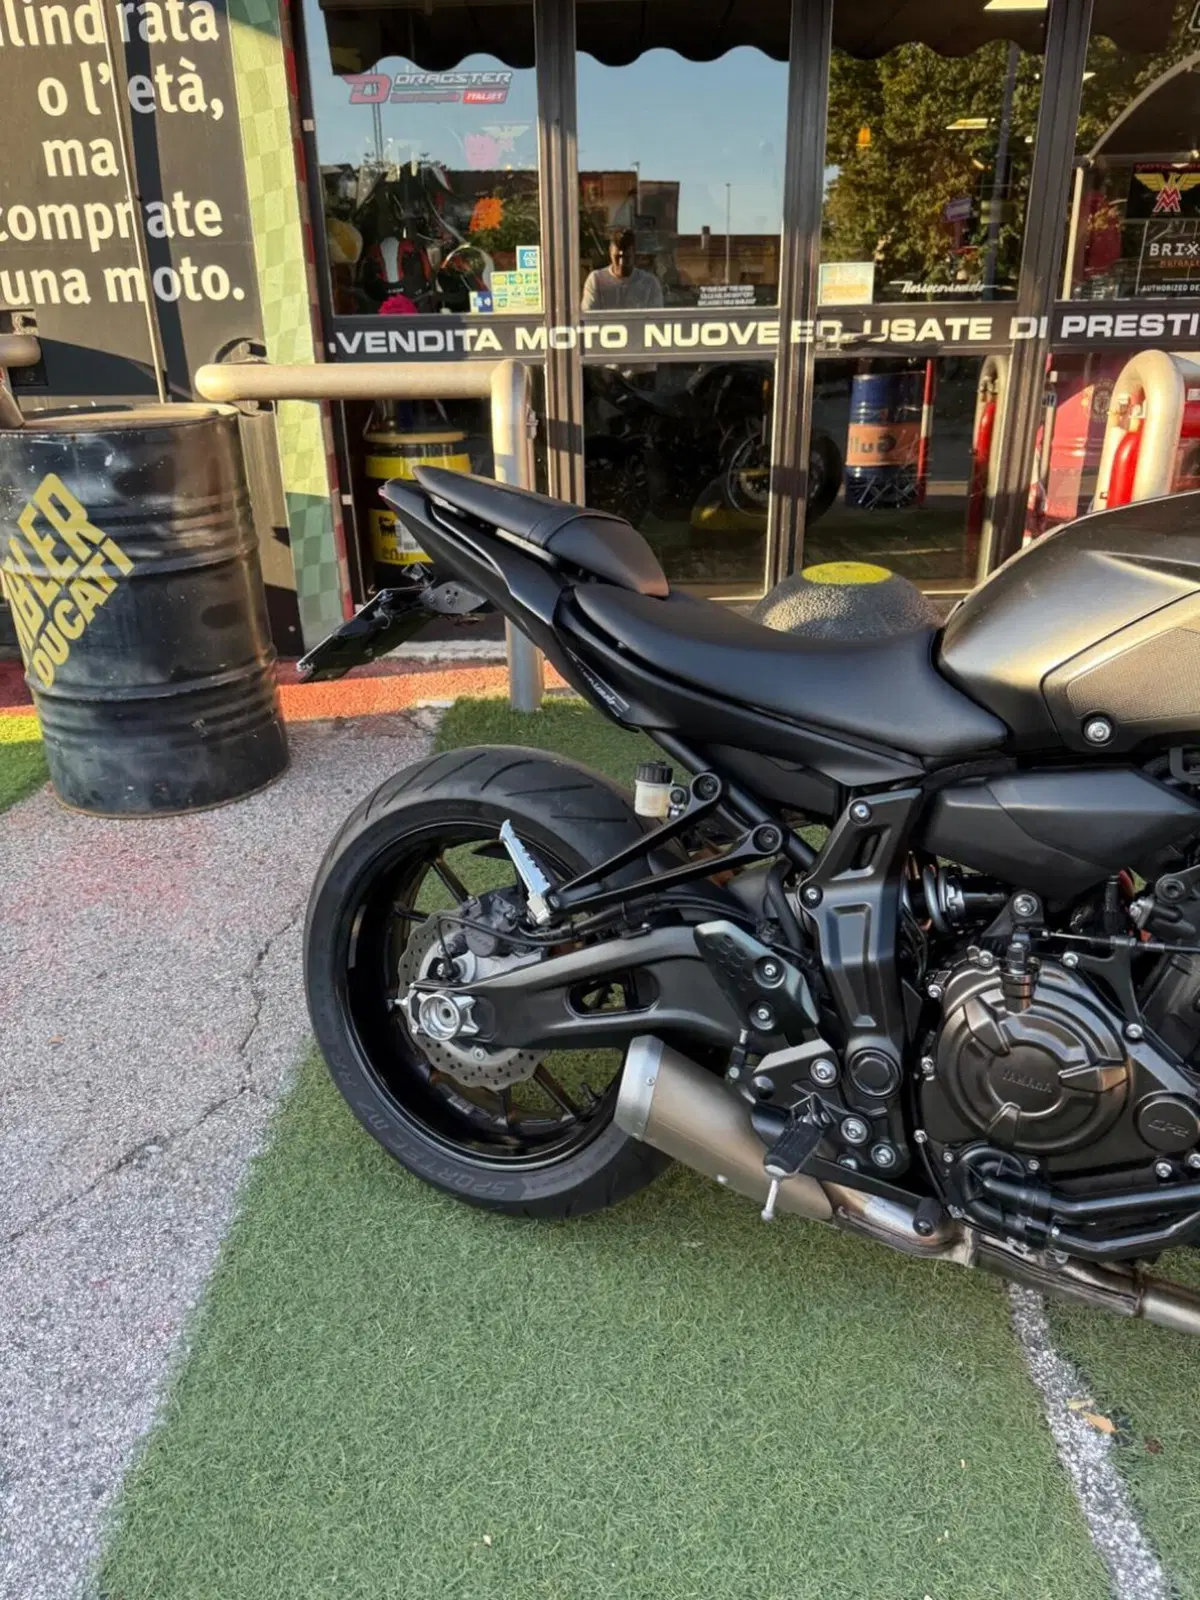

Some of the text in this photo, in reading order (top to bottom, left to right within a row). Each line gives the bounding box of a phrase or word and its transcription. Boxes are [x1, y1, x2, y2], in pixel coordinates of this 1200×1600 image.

[0, 0, 220, 47] lindrata
[37, 76, 68, 116] o
[394, 71, 513, 85] DRAGSTER
[41, 137, 120, 177] ma
[1, 256, 246, 307] una moto.
[1141, 284, 1188, 293] AUTHORIZED
[515, 324, 629, 350] MOTO
[644, 320, 780, 347] NUOVE
[862, 316, 994, 343] USATE
[1008, 315, 1049, 340] DI
[1060, 312, 1200, 338] PRESTI
[31, 537, 136, 688] DUCATI
